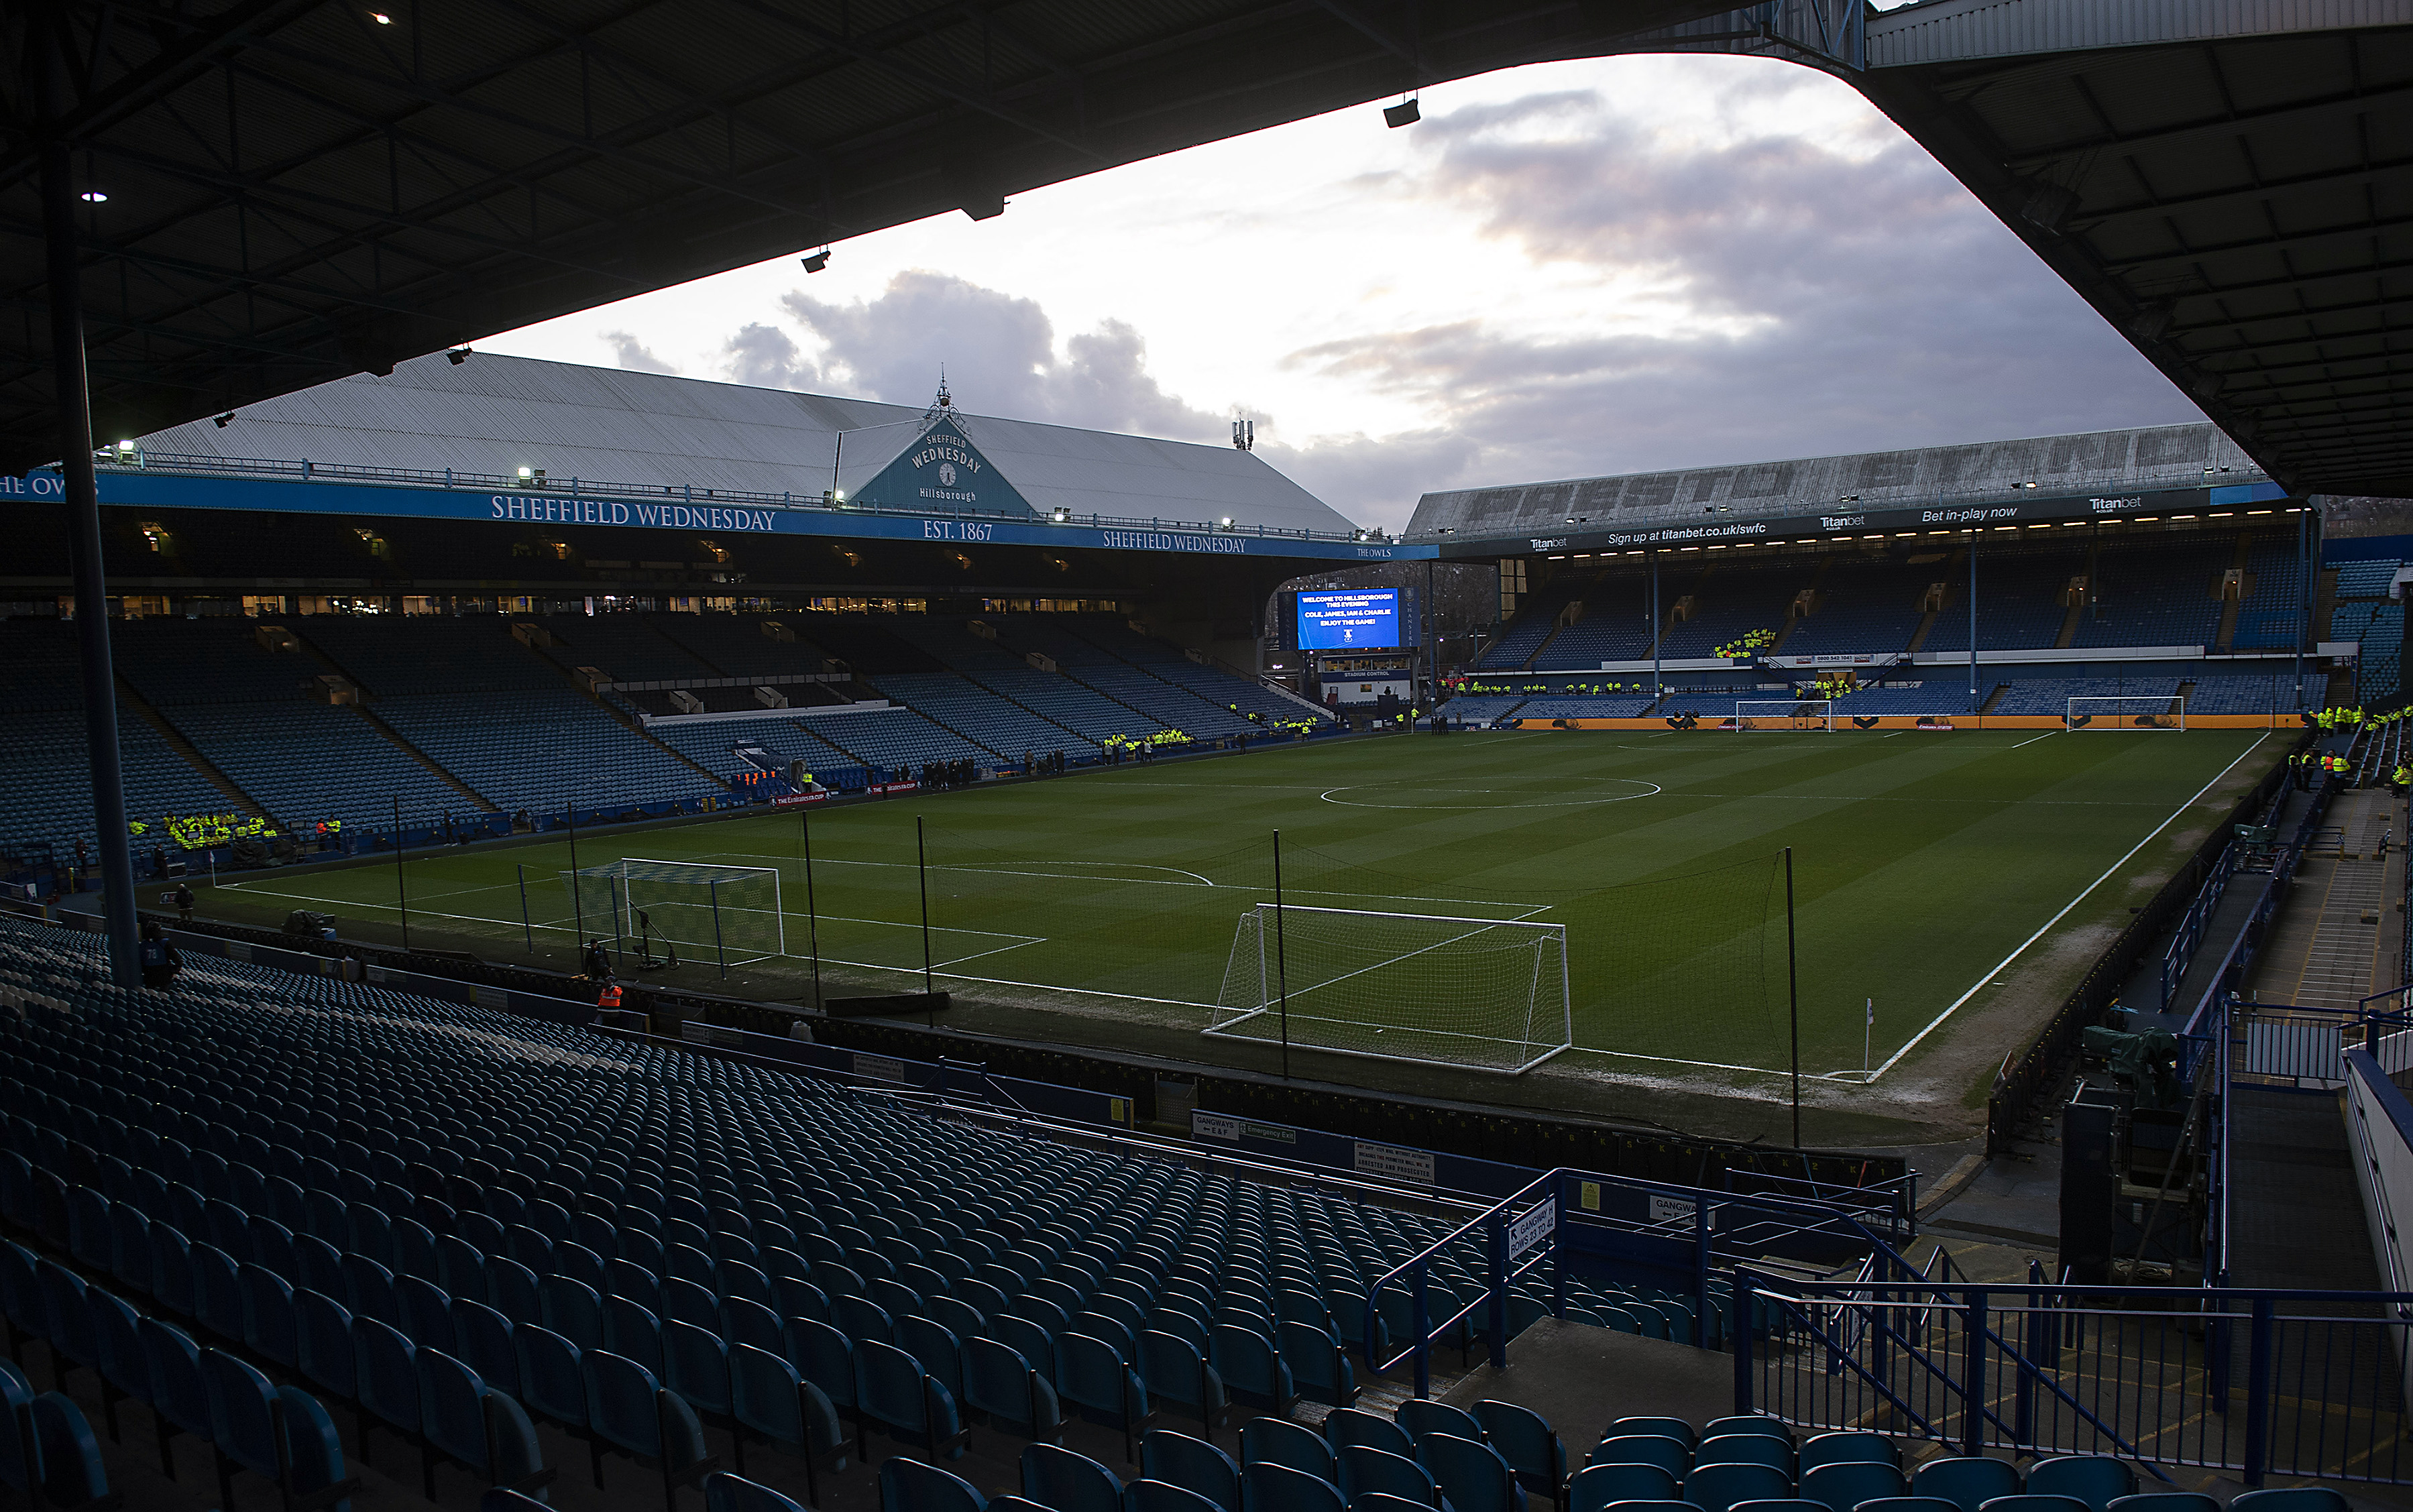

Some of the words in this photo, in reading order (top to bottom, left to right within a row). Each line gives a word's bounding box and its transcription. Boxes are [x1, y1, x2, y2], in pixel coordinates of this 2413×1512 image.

[926, 434, 966, 449] SHEFFIELD
[912, 447, 980, 473] WEDNESDAY
[0, 476, 25, 493] HE
[919, 487, 976, 502] Hillsborough
[2089, 496, 2141, 510] Titanbet
[492, 496, 630, 524] SHEFFIELD
[635, 504, 776, 531] WEDNESDAY
[1922, 510, 1944, 522] Bet
[1946, 508, 1988, 522] in-play
[1990, 507, 2017, 518] now
[1819, 515, 1864, 528] Titanbet
[923, 520, 954, 539] EST.
[959, 524, 992, 541] 1867
[1608, 534, 1630, 545] Sign
[1633, 534, 1647, 544] up
[1649, 531, 1659, 540] at
[1662, 523, 1766, 540] titanbet.co.uk/swfc
[1103, 530, 1171, 550] SHEFFIELD
[1174, 536, 1246, 554] WEDNESDAY
[1530, 537, 1567, 548] Titanbet
[1357, 548, 1368, 557] THE
[1369, 549, 1391, 557] OWLS
[1197, 1116, 1234, 1128] GANGWAYS
[1247, 1125, 1281, 1138] Emergency
[1659, 1145, 1665, 1153] K
[1358, 1159, 1383, 1168] ARRESTED
[1850, 1166, 1856, 1174] K
[1657, 1199, 1696, 1213] GANGWA
[1520, 1210, 1547, 1234] GANGWAY
[1547, 1206, 1553, 1214] H
[1510, 1239, 1528, 1255] ROWS
[1529, 1232, 1537, 1242] 23
[1538, 1226, 1546, 1236] TO
[1547, 1219, 1554, 1229] 42
